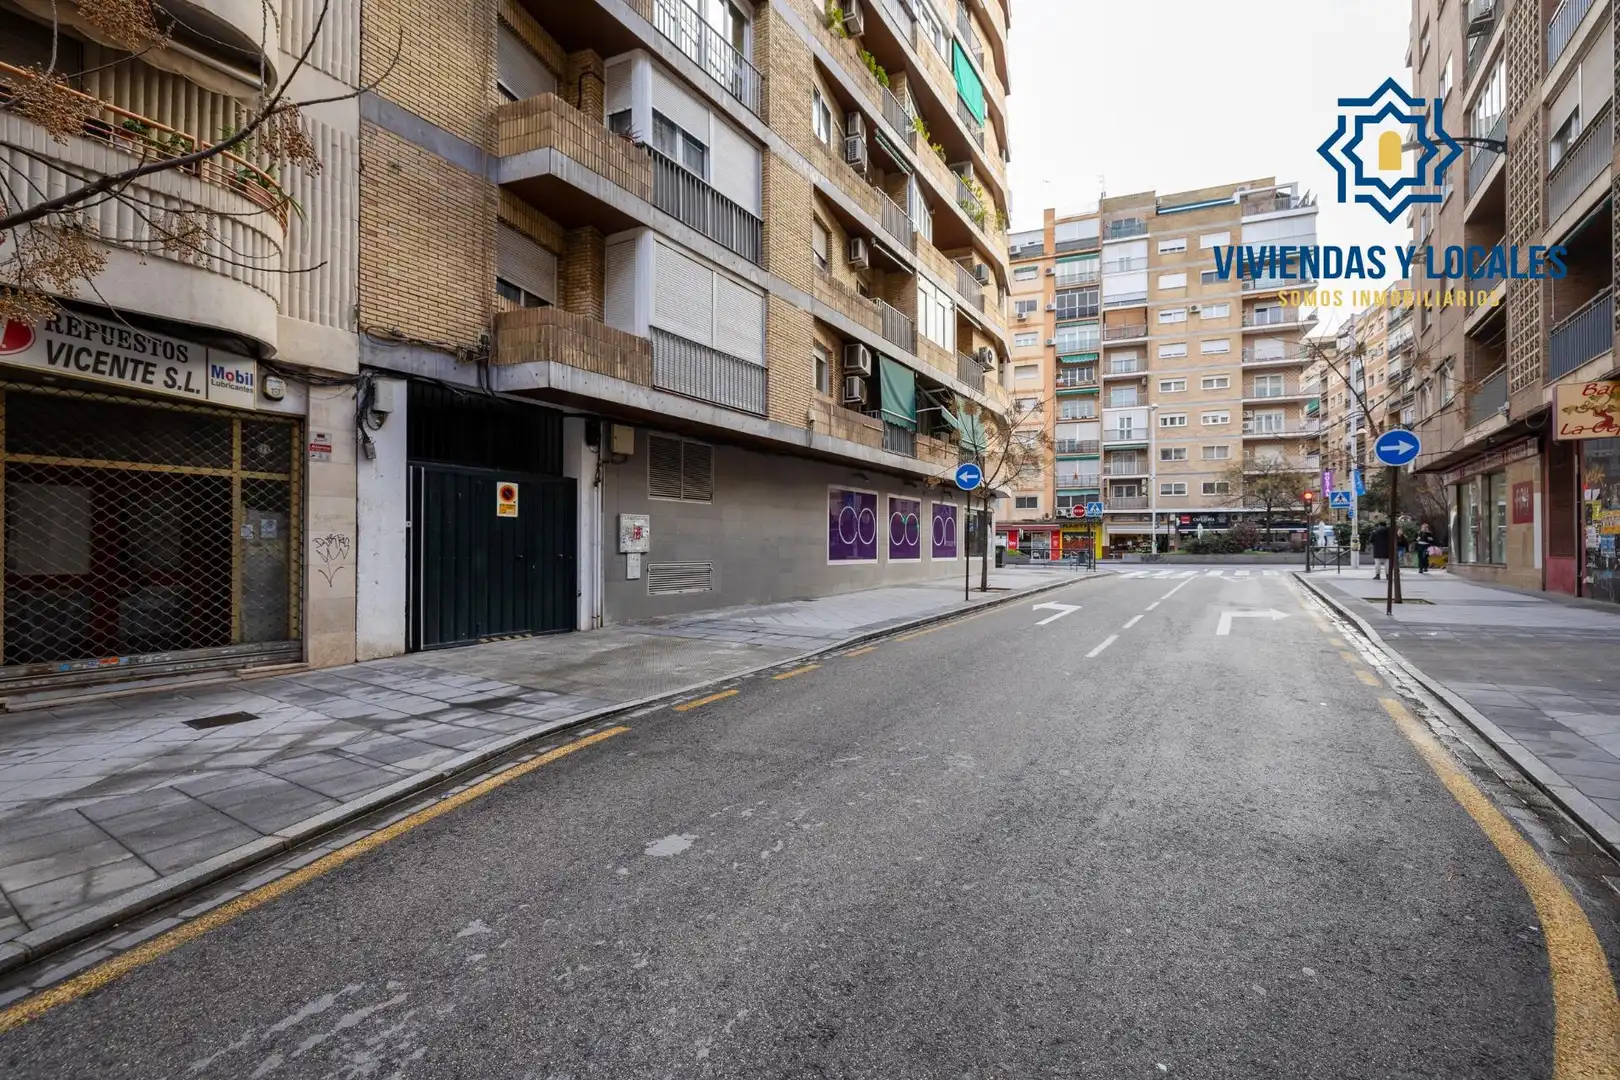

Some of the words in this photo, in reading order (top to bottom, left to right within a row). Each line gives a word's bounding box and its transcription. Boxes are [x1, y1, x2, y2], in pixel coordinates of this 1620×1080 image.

[44, 311, 189, 364] REPUESTOS
[46, 339, 158, 385] VICENTE
[163, 366, 201, 394] S.L.
[211, 364, 253, 387] Mobil
[211, 378, 255, 394] Lubricantes
